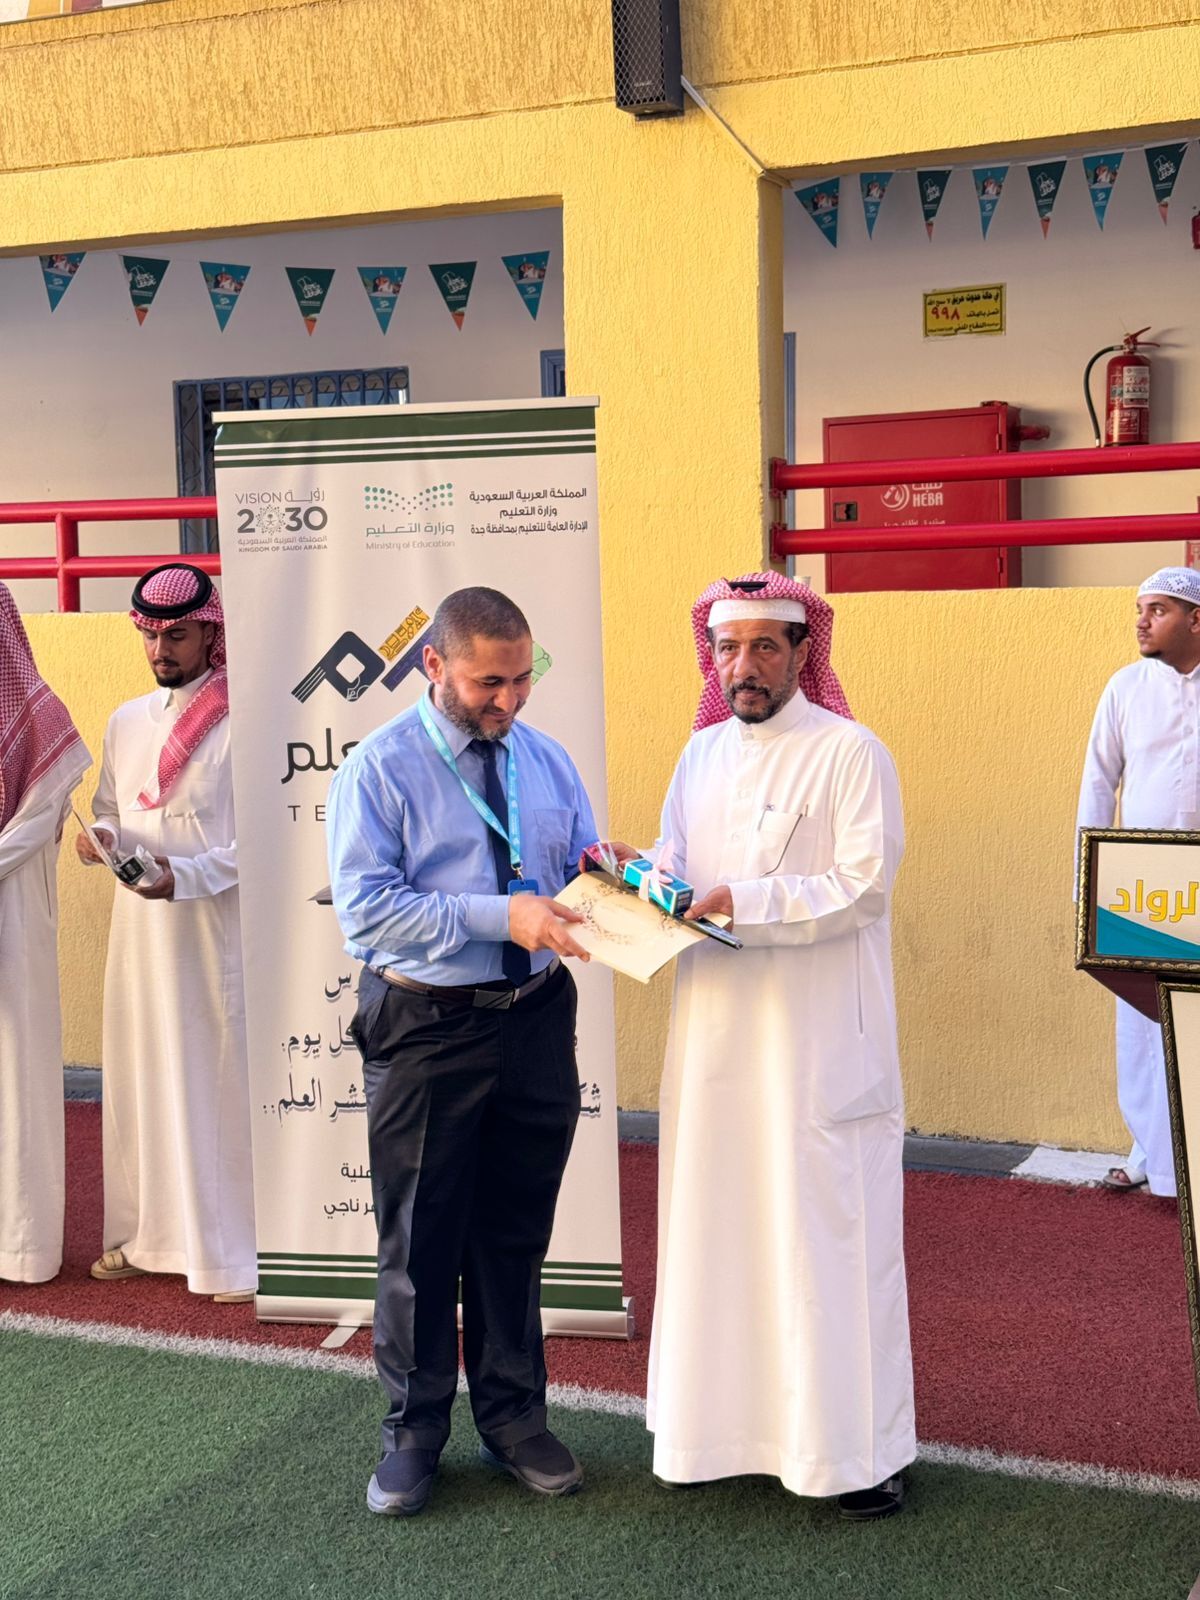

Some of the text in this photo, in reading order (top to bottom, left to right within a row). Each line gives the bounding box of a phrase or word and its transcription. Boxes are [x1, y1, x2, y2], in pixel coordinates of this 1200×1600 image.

[931, 306, 960, 320] ٩٩٨
[235, 491, 282, 504] VISION
[469, 488, 587, 504] المملكة العربية السعودية
[912, 491, 944, 507] HEBA
[499, 505, 558, 519] وزارة التعليم
[366, 521, 455, 537] وزارة التعليم
[470, 524, 485, 536] جدة
[486, 523, 518, 535] بمحافظة
[518, 522, 546, 535] للتعليم
[547, 520, 569, 532] العامة
[238, 535, 328, 546] المملكة العربية السعودية
[366, 540, 456, 551] Ministry of Education
[323, 1198, 359, 1219] ناجي
